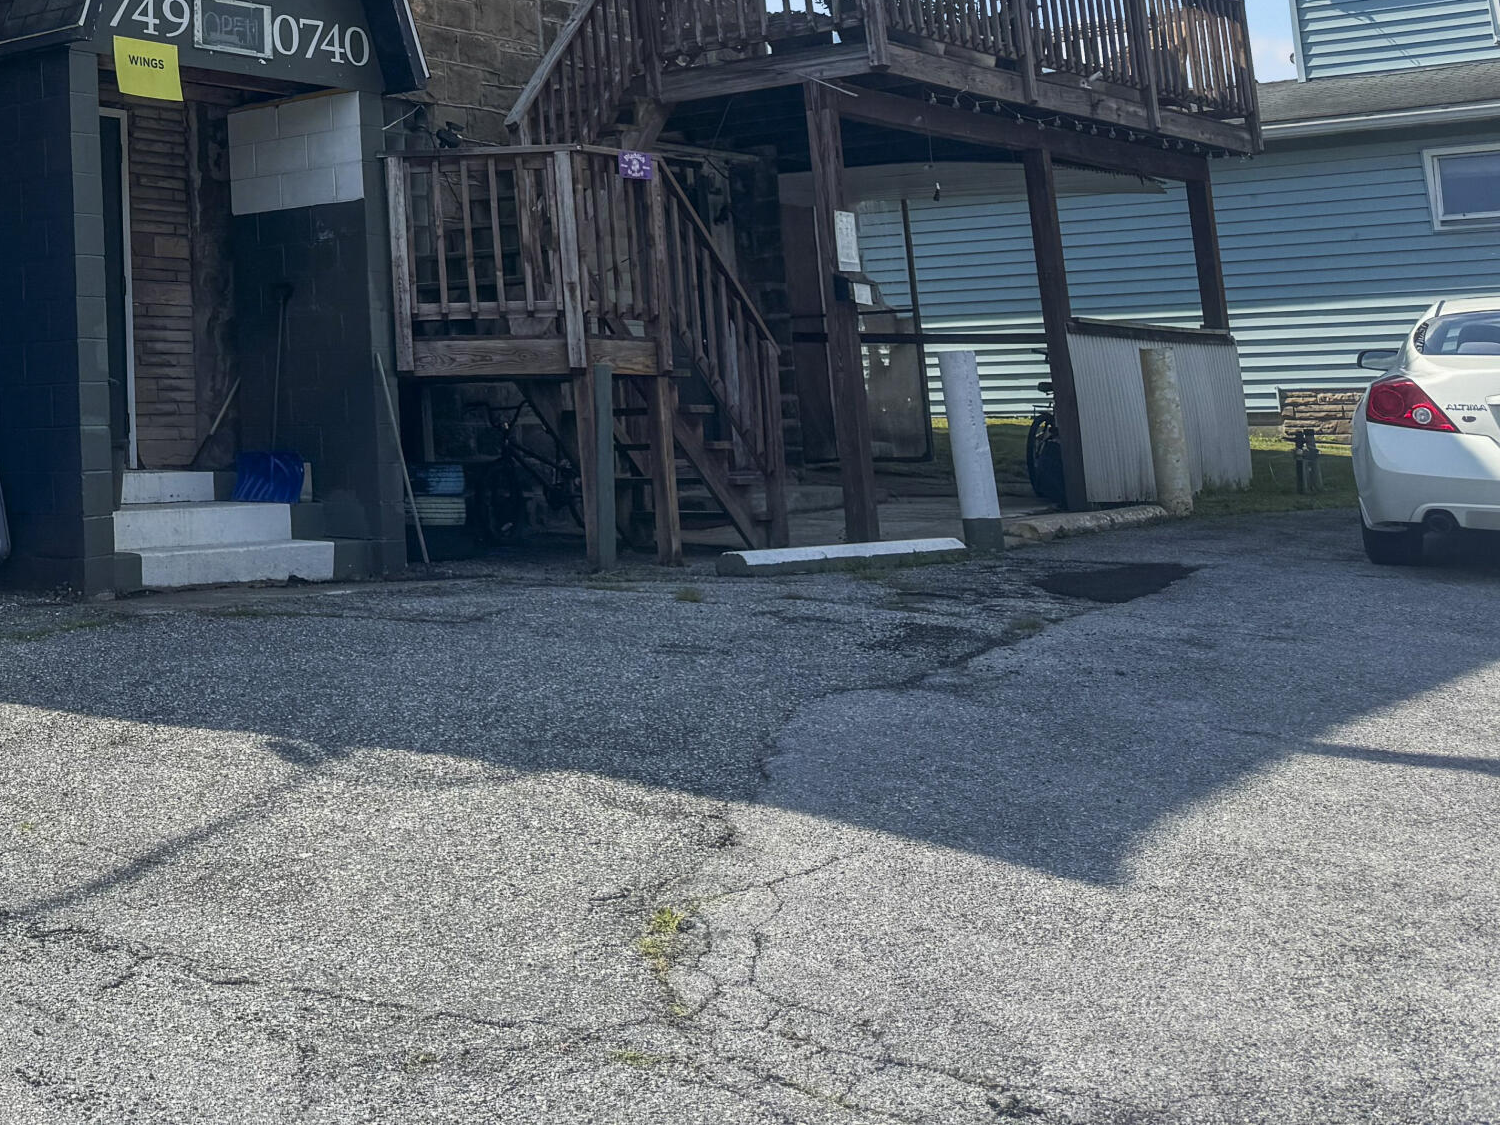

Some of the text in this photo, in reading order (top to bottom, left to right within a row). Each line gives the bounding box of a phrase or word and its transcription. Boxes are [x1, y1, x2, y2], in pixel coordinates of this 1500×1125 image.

[203, 11, 258, 45] OPEN
[273, 14, 370, 66] 0740
[128, 54, 165, 70] WINGS
